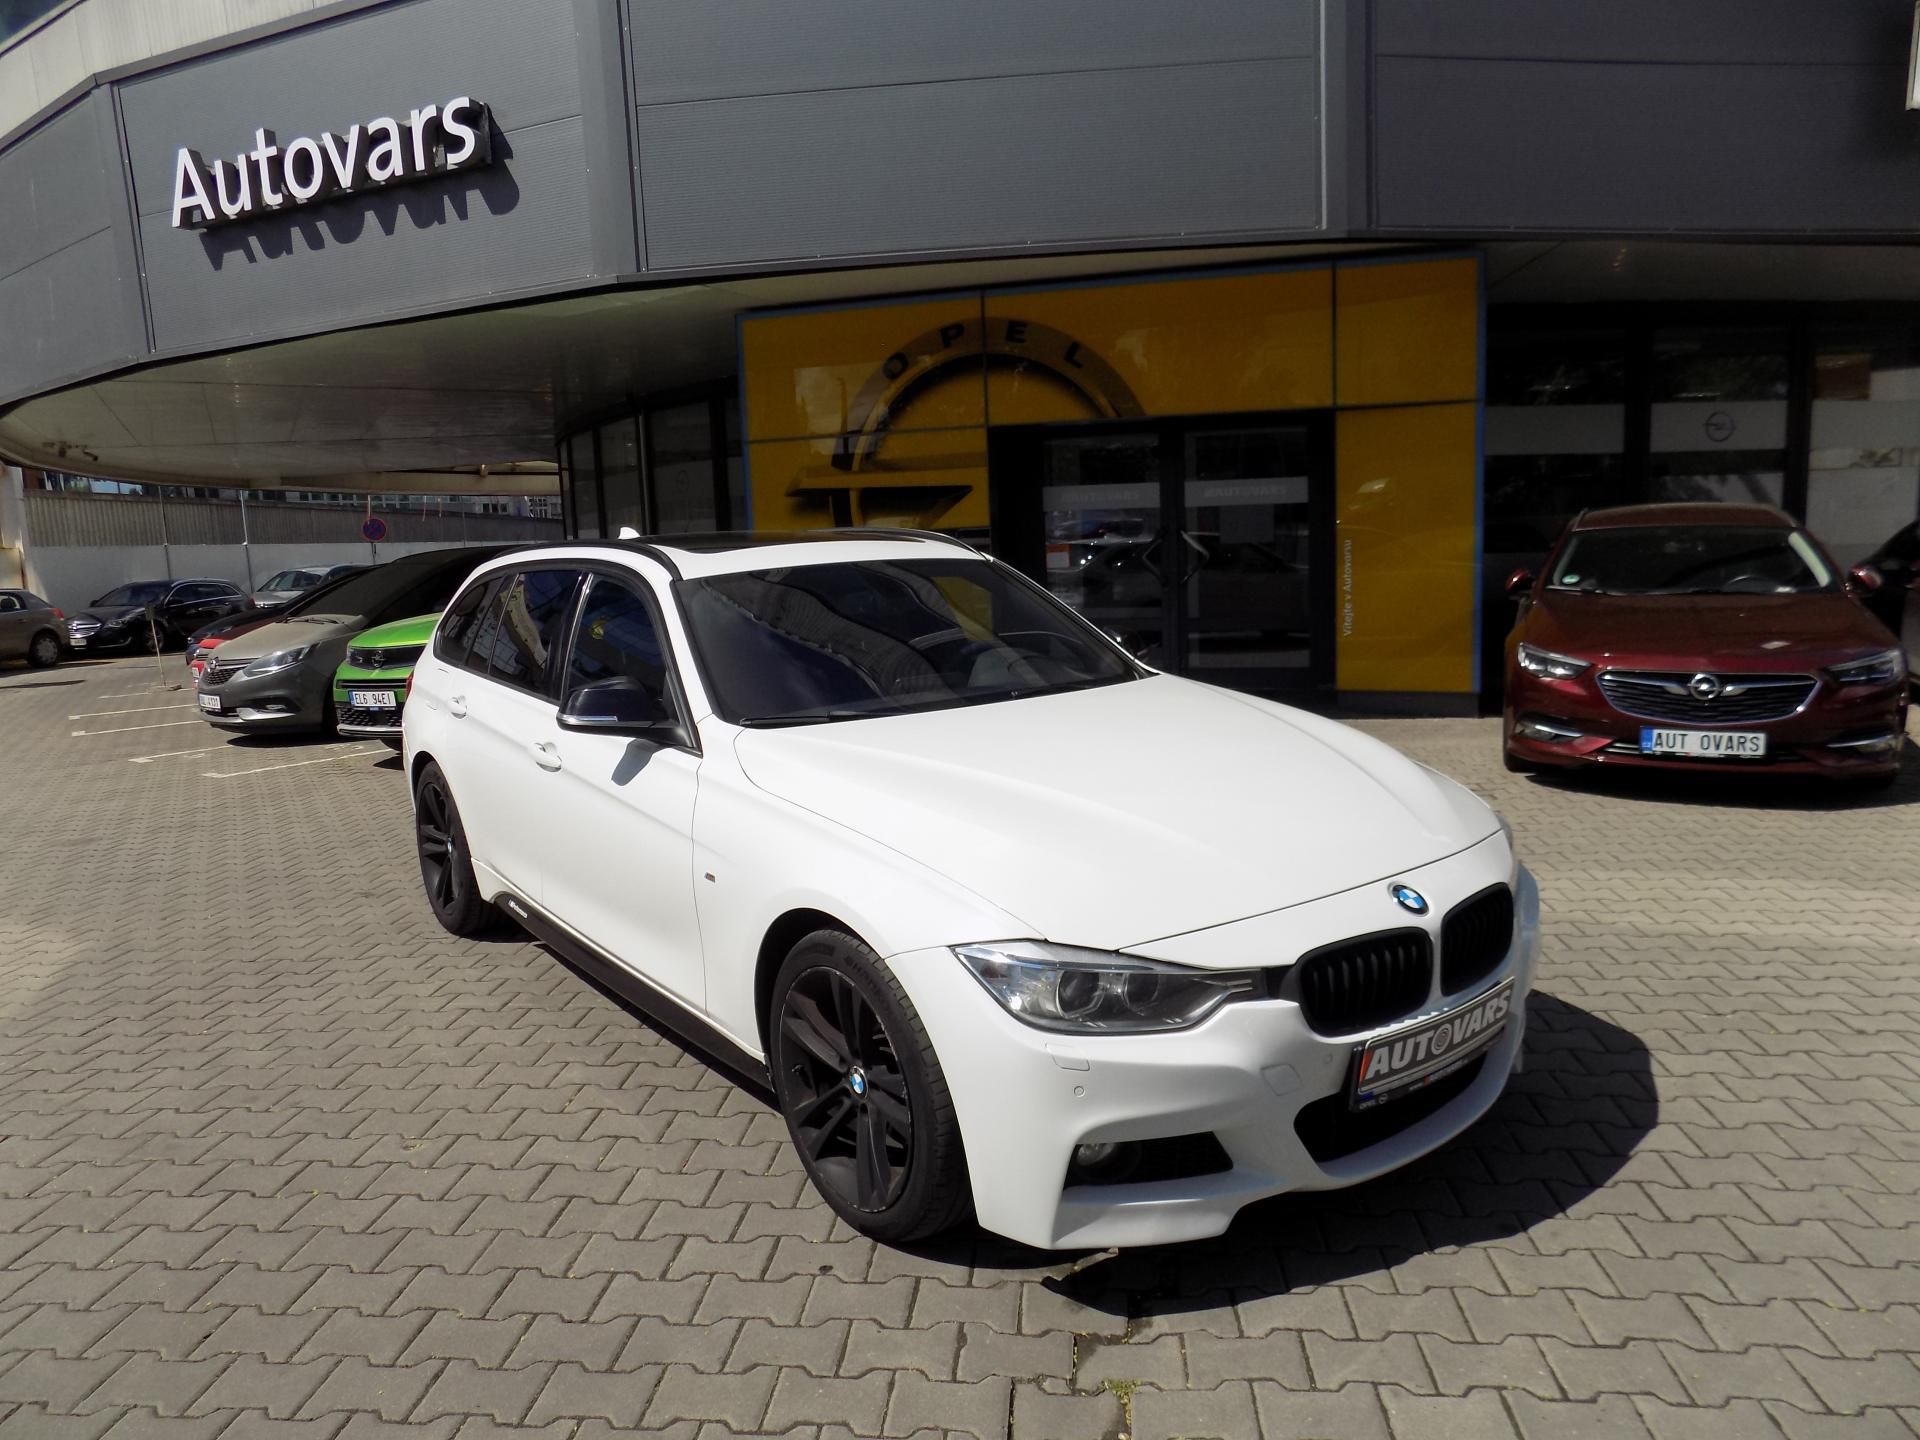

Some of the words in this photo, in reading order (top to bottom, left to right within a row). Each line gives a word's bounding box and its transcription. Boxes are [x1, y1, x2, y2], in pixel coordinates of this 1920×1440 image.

[171, 96, 477, 228] Autovars
[882, 319, 1084, 380] OPEL
[354, 693, 368, 705] EL6
[1654, 732, 1688, 750] AUT
[1700, 734, 1760, 753] OVARS
[1365, 989, 1512, 1080] AUTOVARS
